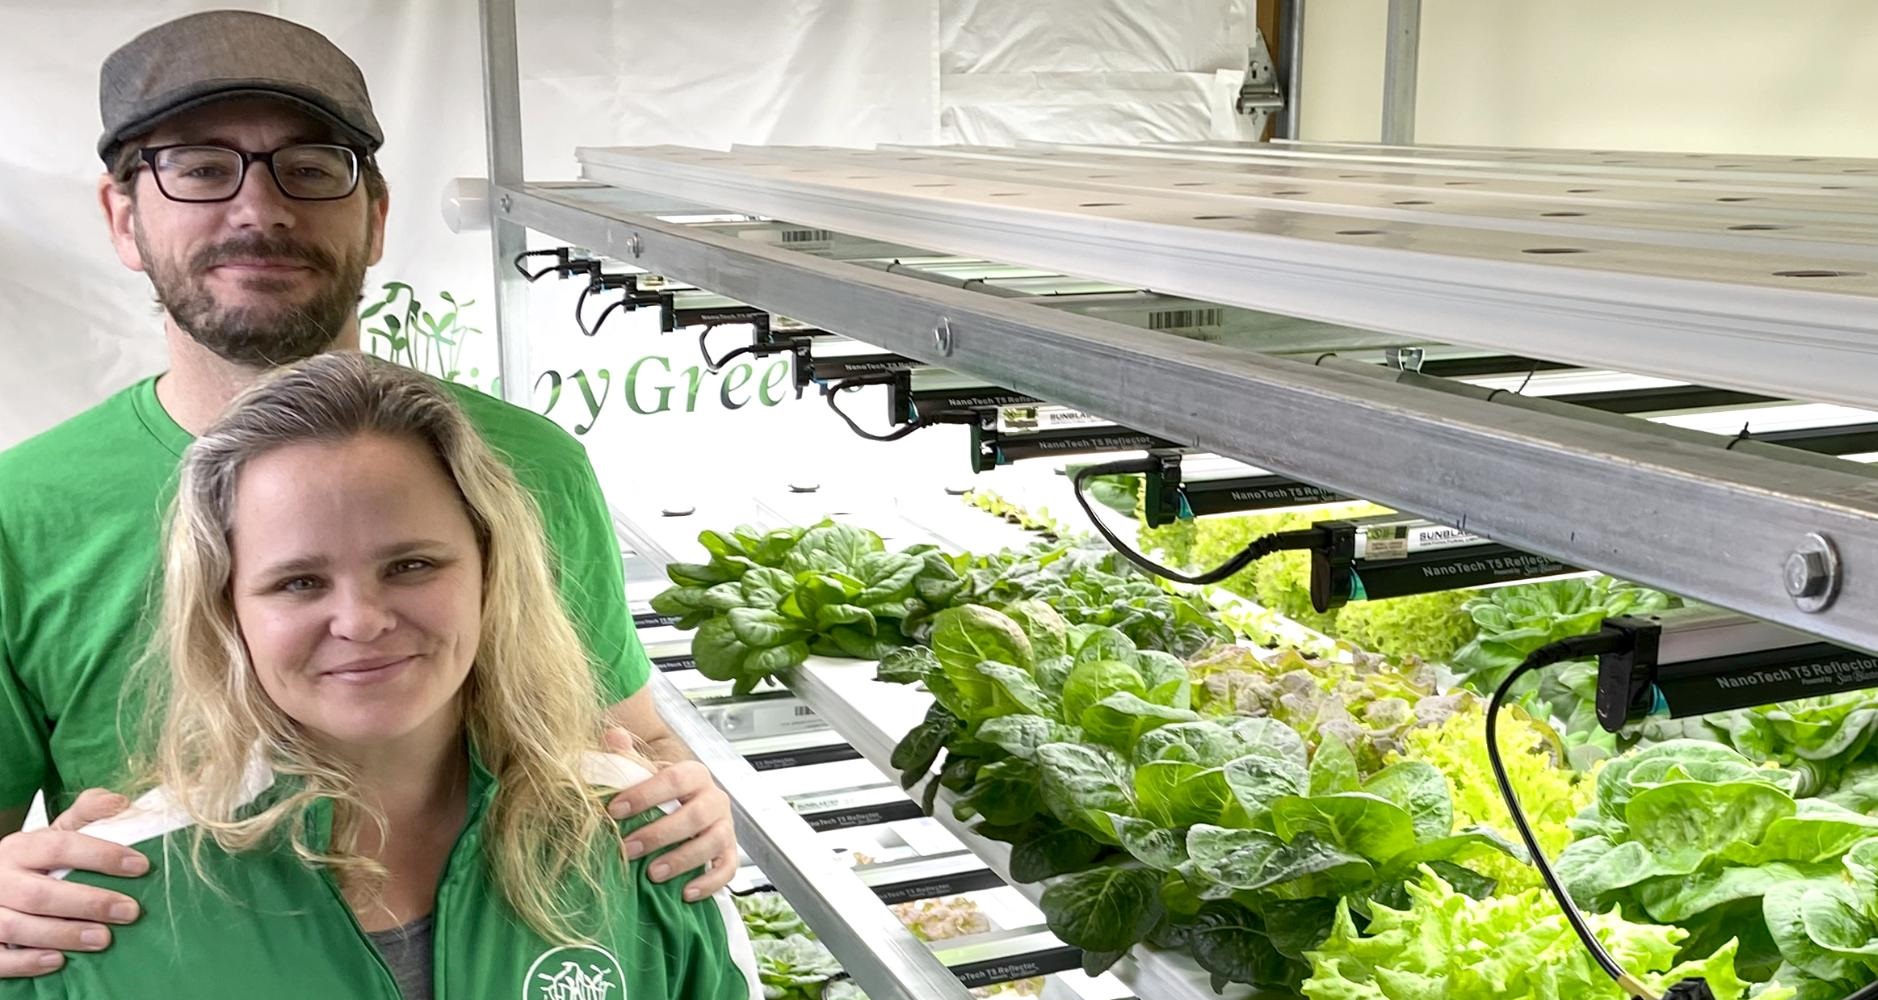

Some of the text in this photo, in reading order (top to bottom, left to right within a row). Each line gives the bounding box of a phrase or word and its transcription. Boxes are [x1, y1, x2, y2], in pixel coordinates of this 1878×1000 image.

[949, 398, 994, 406] NanoTech
[1040, 440, 1090, 449] NanoTech
[1105, 437, 1150, 447] Reflector
[1231, 488, 1287, 501] NanoTech
[1422, 560, 1486, 577] NanoTech
[1487, 559, 1503, 569] T5
[1716, 670, 1793, 689] NanoTech
[1791, 665, 1812, 679] T5
[998, 962, 1036, 974] Reflector
